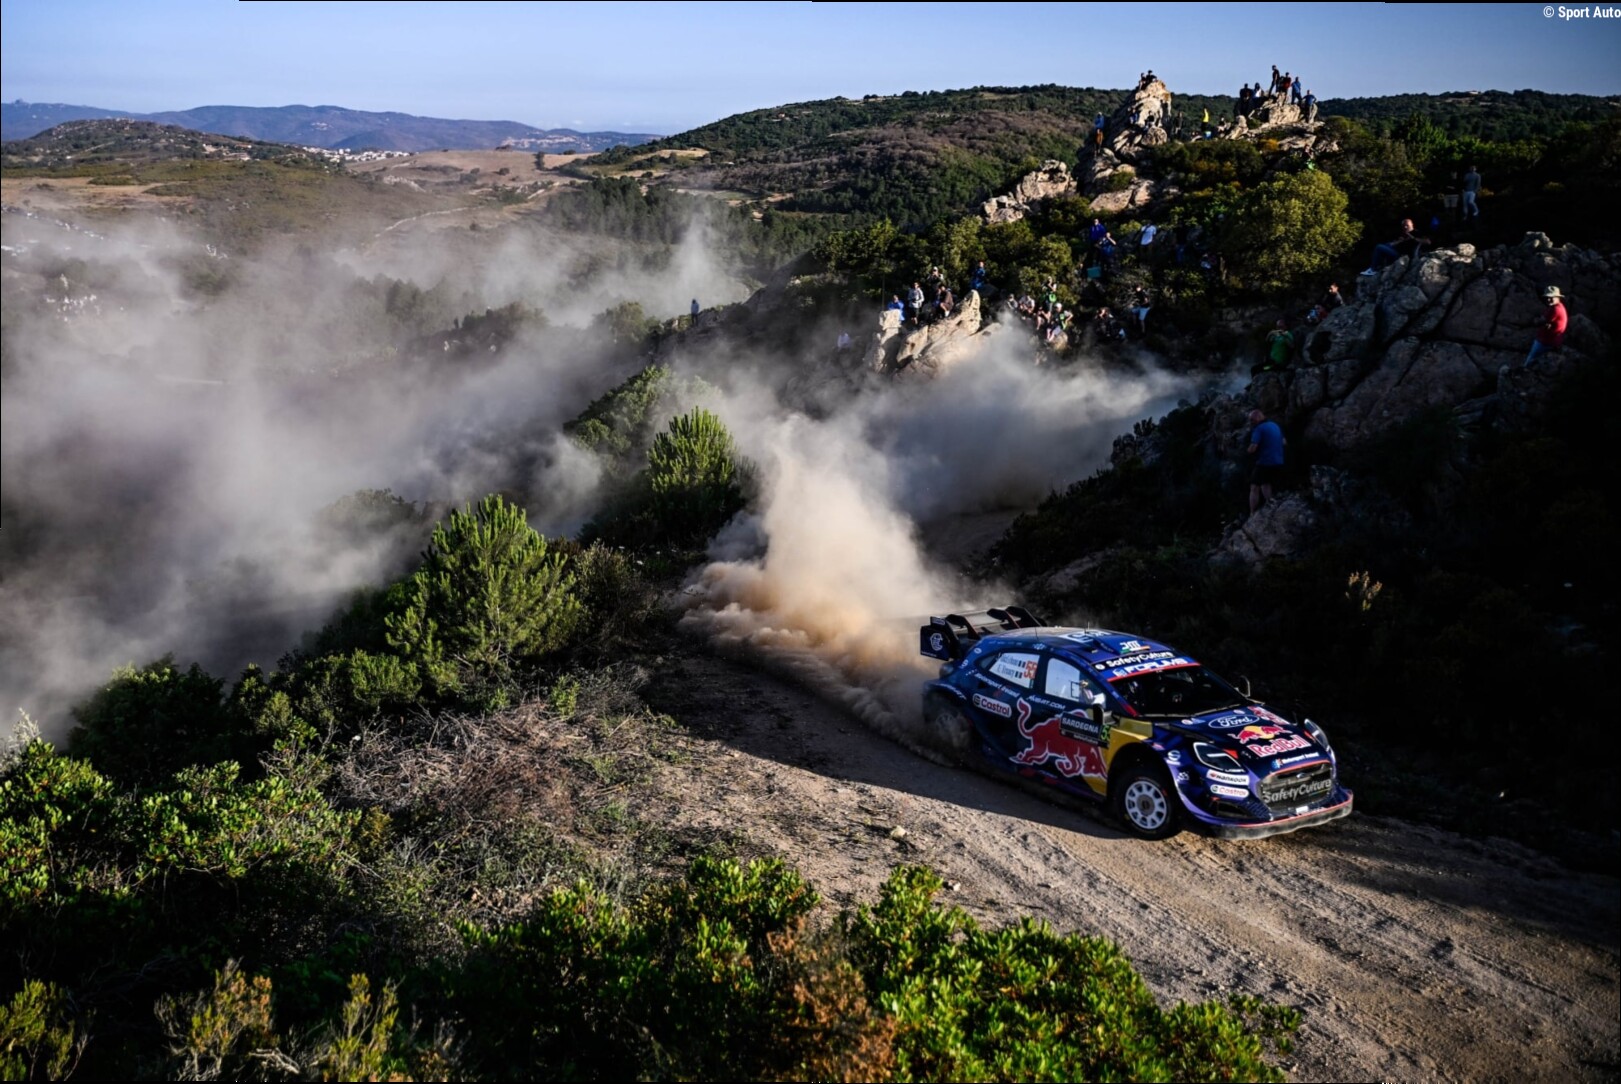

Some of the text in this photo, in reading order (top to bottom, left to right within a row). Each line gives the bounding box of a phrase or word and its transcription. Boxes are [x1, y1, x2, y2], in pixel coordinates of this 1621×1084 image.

[1024, 660, 1038, 680] 55
[980, 698, 1010, 717] Castrol
[1062, 717, 1099, 734] SARDEGNA
[1217, 716, 1253, 728] Ford
[1262, 779, 1332, 804] SafetyCulture
